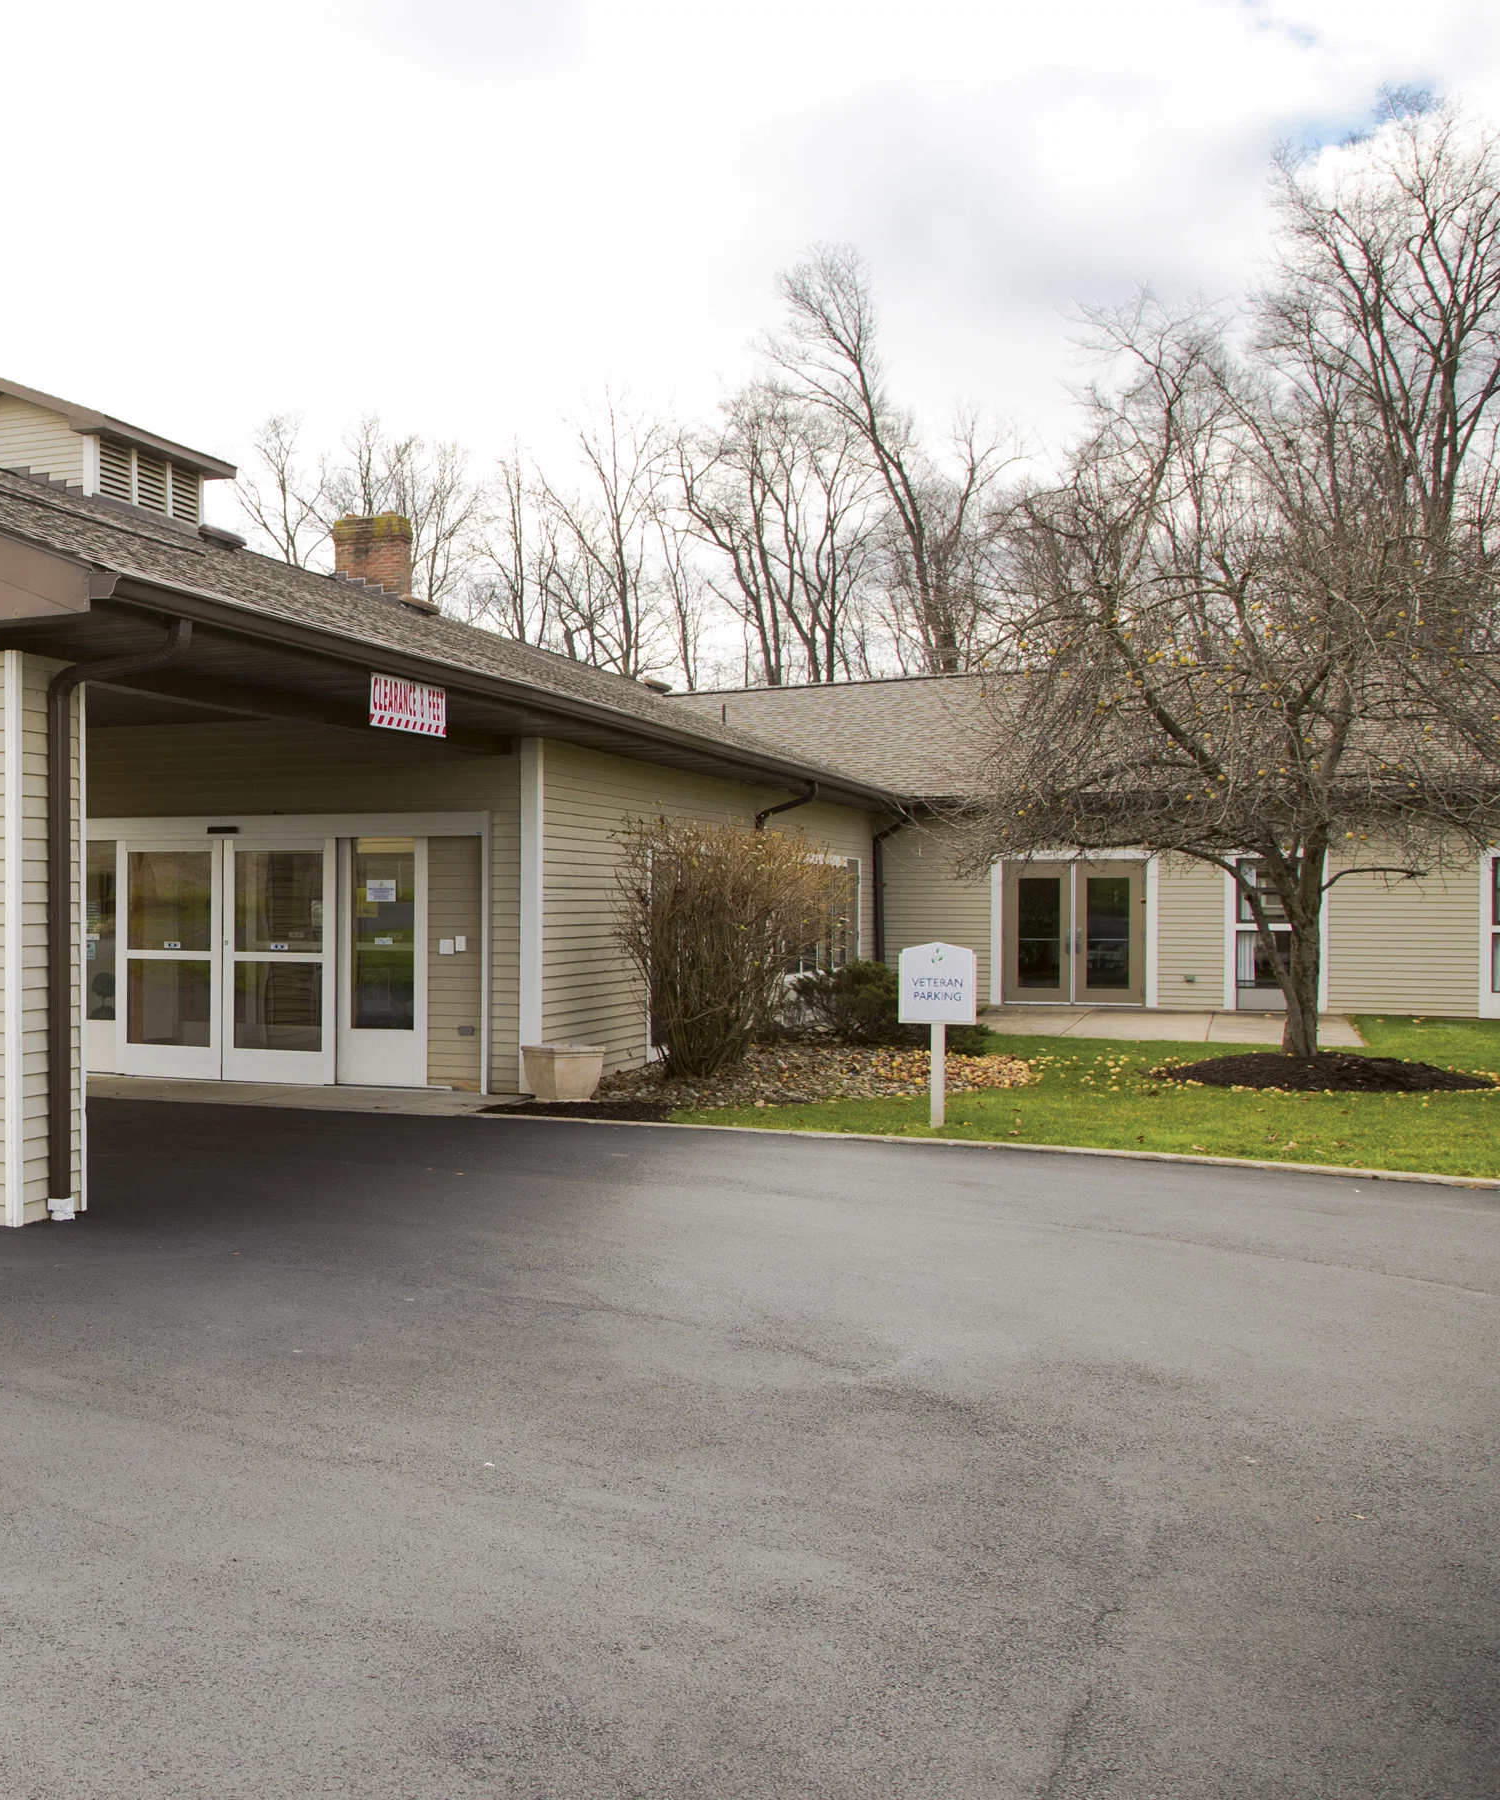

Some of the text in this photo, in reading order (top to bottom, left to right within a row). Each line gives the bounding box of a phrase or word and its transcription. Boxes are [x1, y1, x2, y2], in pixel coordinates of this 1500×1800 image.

[372, 677, 416, 717] CLEARANCE
[427, 689, 444, 722] FEET
[911, 977, 963, 987] VETERAN
[913, 991, 961, 1001] PARKING
